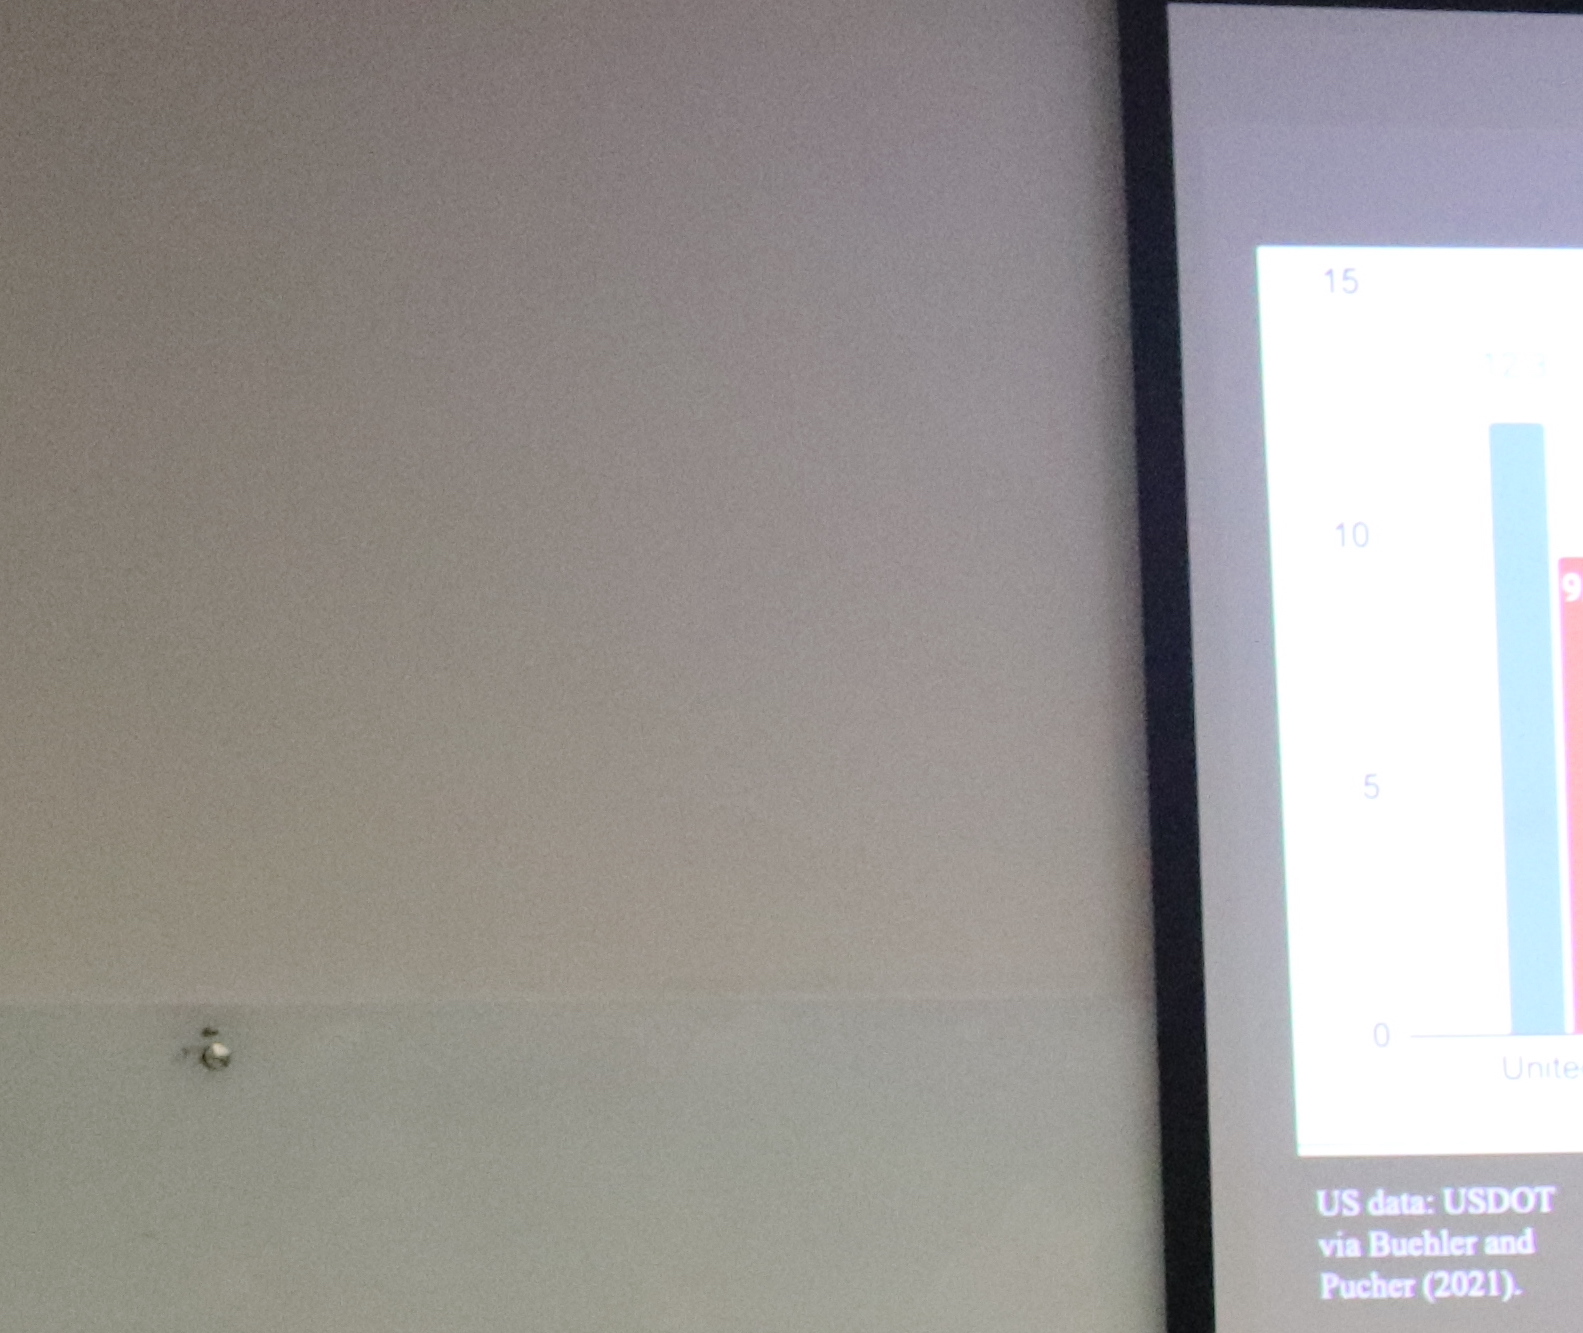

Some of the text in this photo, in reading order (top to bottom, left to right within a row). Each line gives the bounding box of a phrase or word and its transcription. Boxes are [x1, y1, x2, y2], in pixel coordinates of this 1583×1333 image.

[1323, 268, 1360, 294] 15
[1335, 523, 1370, 549] 10
[1363, 774, 1379, 800] 5
[1374, 1024, 1390, 1049] 0
[1317, 1186, 1555, 1217] US data: USDOT
[1319, 1228, 1535, 1259] via Buehler and
[1320, 1270, 1521, 1302] Pucher (2021).
